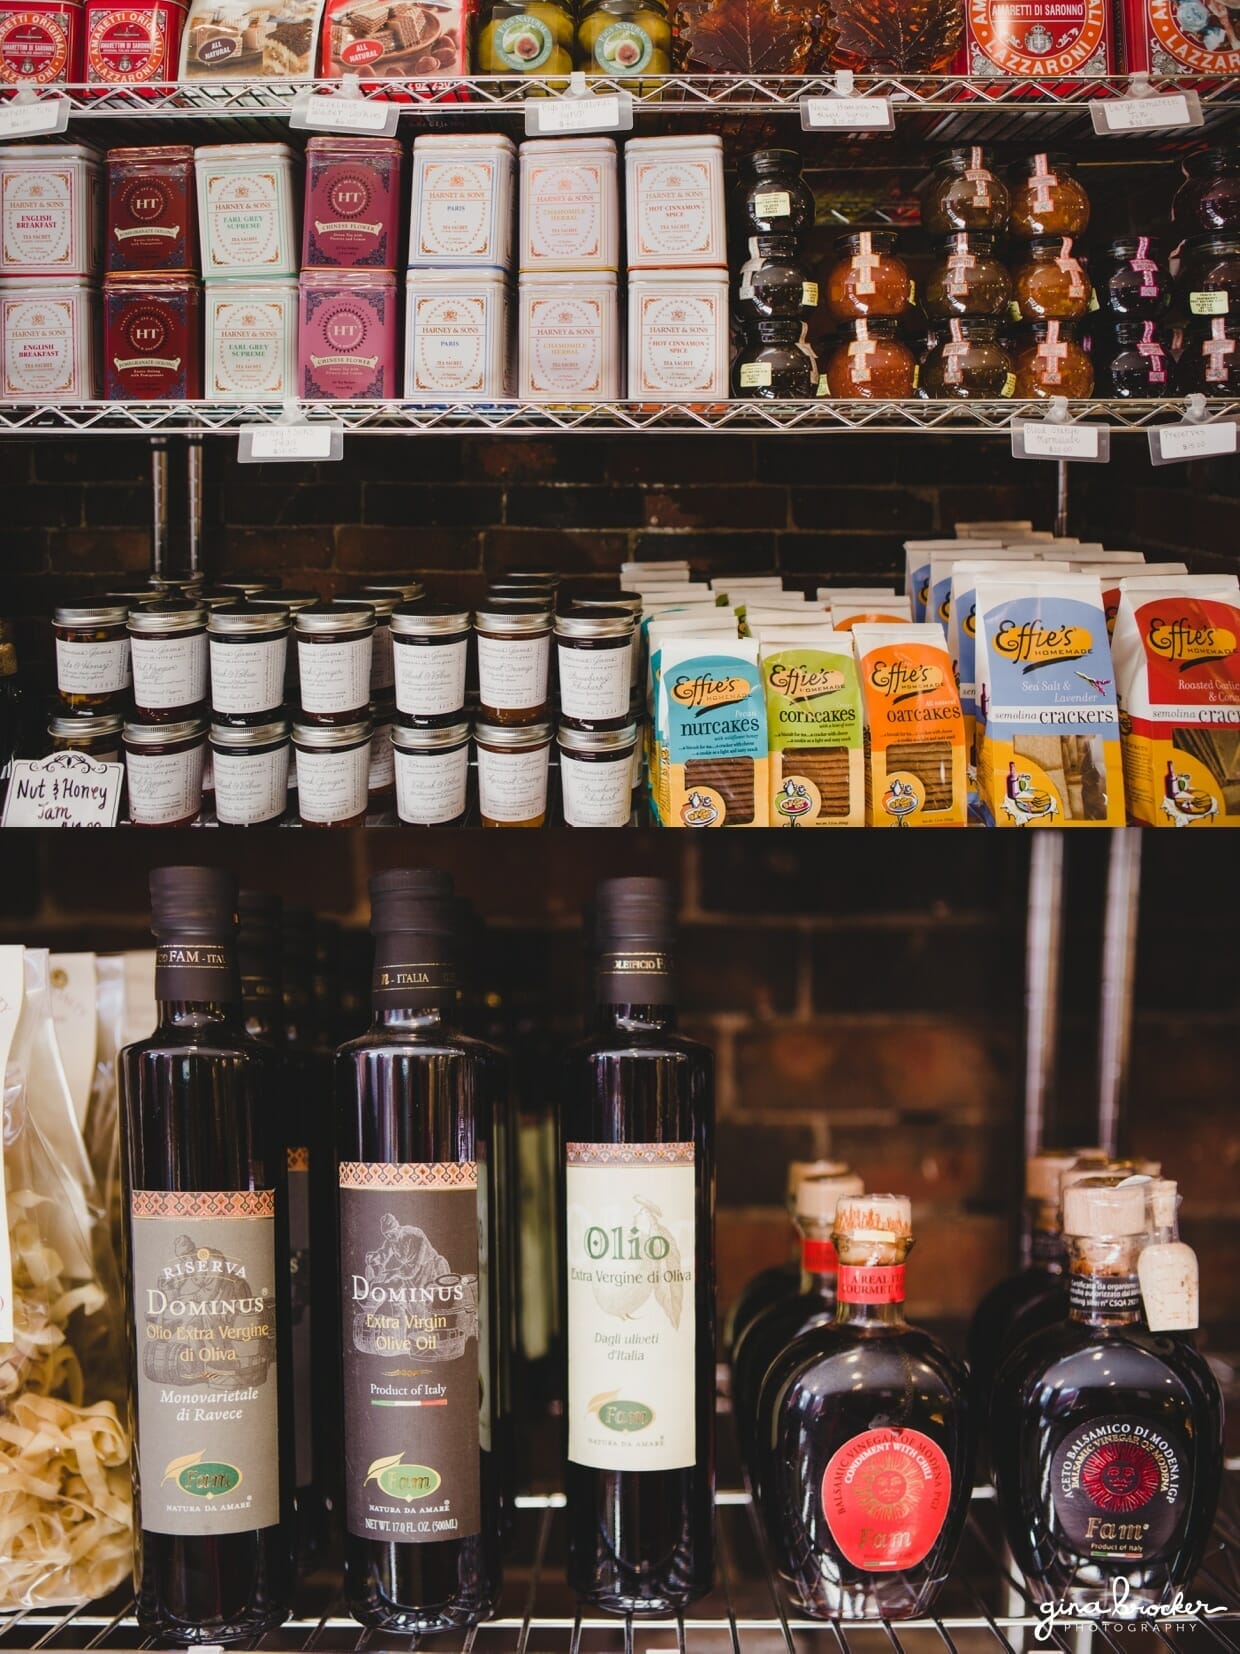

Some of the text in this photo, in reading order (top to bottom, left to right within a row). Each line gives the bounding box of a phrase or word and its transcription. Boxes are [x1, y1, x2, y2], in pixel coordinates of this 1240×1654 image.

[992, 2, 1084, 17] AMARETTI DI SARONNO
[32, 14, 65, 60] ORIGINALI
[91, 13, 126, 55] AMARETTI
[211, 41, 222, 49] ALL
[356, 44, 367, 52] ALL
[204, 47, 231, 59] NATURAL
[349, 50, 378, 62] NATURAL
[987, 40, 1091, 75] LAZZARONI
[96, 63, 154, 82] LAZZARONI
[136, 198, 158, 209] HT
[338, 192, 362, 202] HT
[649, 203, 701, 213] HOT CINNAMON
[16, 221, 57, 229] BREAKFAST
[226, 222, 261, 230] SUPREME
[243, 215, 263, 223] GREY
[136, 328, 158, 339] HT
[333, 325, 357, 336] HT
[454, 327, 460, 335] &
[649, 326, 709, 335] HARNEY & SONS
[23, 343, 54, 351] ENGLISH
[249, 343, 269, 351] GREY
[652, 340, 705, 348] HOT CINNAMON
[669, 347, 688, 355] SPICE
[19, 350, 59, 358] BREAKFAST
[231, 350, 266, 358] SUPREME
[995, 619, 1074, 664] Effie's
[1149, 617, 1215, 663] Effie's
[1034, 648, 1093, 657] HOMEMADE
[768, 663, 831, 697] Effie's
[871, 660, 929, 697] Effie's
[1022, 680, 1071, 691] Sea Salt &
[1179, 679, 1214, 690] Roasted
[672, 672, 737, 710] Effie's
[1054, 693, 1098, 704] Lavender
[886, 706, 961, 723] oatcakes
[995, 709, 1114, 725] semolina crackers
[1152, 708, 1196, 719] semolina
[681, 718, 760, 737] nutcakes
[17, 778, 46, 799] Nut
[63, 778, 107, 810] Honey
[37, 801, 72, 820] Jam
[169, 950, 199, 963] FAM
[397, 973, 430, 984] ITALIA
[584, 1226, 670, 1260] Olio
[162, 1259, 247, 1281] RISERVA
[571, 1267, 692, 1288] Extra Vergine di Oliva
[851, 1274, 887, 1284] A REAL
[351, 1274, 464, 1303] DOMINUS
[146, 1288, 264, 1316] DOMINUS
[366, 1313, 447, 1333] Extra Virgin
[146, 1323, 269, 1342] Olio Extra Vergine
[594, 1331, 660, 1347] Dagli uliveti
[376, 1335, 437, 1351] Olive Oil
[180, 1346, 236, 1361] di Oliva
[608, 1349, 645, 1361] d'Italia
[160, 1386, 259, 1404] Monovarietale
[370, 1383, 447, 1397] Product of Italy
[176, 1408, 243, 1422] di Ravece
[587, 1437, 618, 1447] NATURA
[1066, 1423, 1131, 1463] BALSAMICO
[844, 1443, 933, 1485] CONDIMENT WITH CHILI
[1071, 1433, 1170, 1493] BALSAMIC VINEGAR OF MODENA
[1149, 1433, 1181, 1482] MODENA
[833, 1435, 943, 1515] BALSAMIC VINEGAR OF MODENA PGI
[1061, 1462, 1075, 1499] ACETO
[1165, 1483, 1181, 1505] IGP
[166, 1501, 251, 1513] NATURA DA AMARE
[369, 1503, 451, 1515] NATURA DA AMARE
[365, 1517, 377, 1530] NET
[377, 1519, 391, 1531] WT.
[406, 1520, 418, 1532] FL.
[418, 1519, 431, 1532] OZ.
[432, 1518, 458, 1532] (500ML)
[1085, 1517, 1143, 1541] Fam
[858, 1526, 912, 1550] Fam
[1090, 1541, 1145, 1553] Product of Italy
